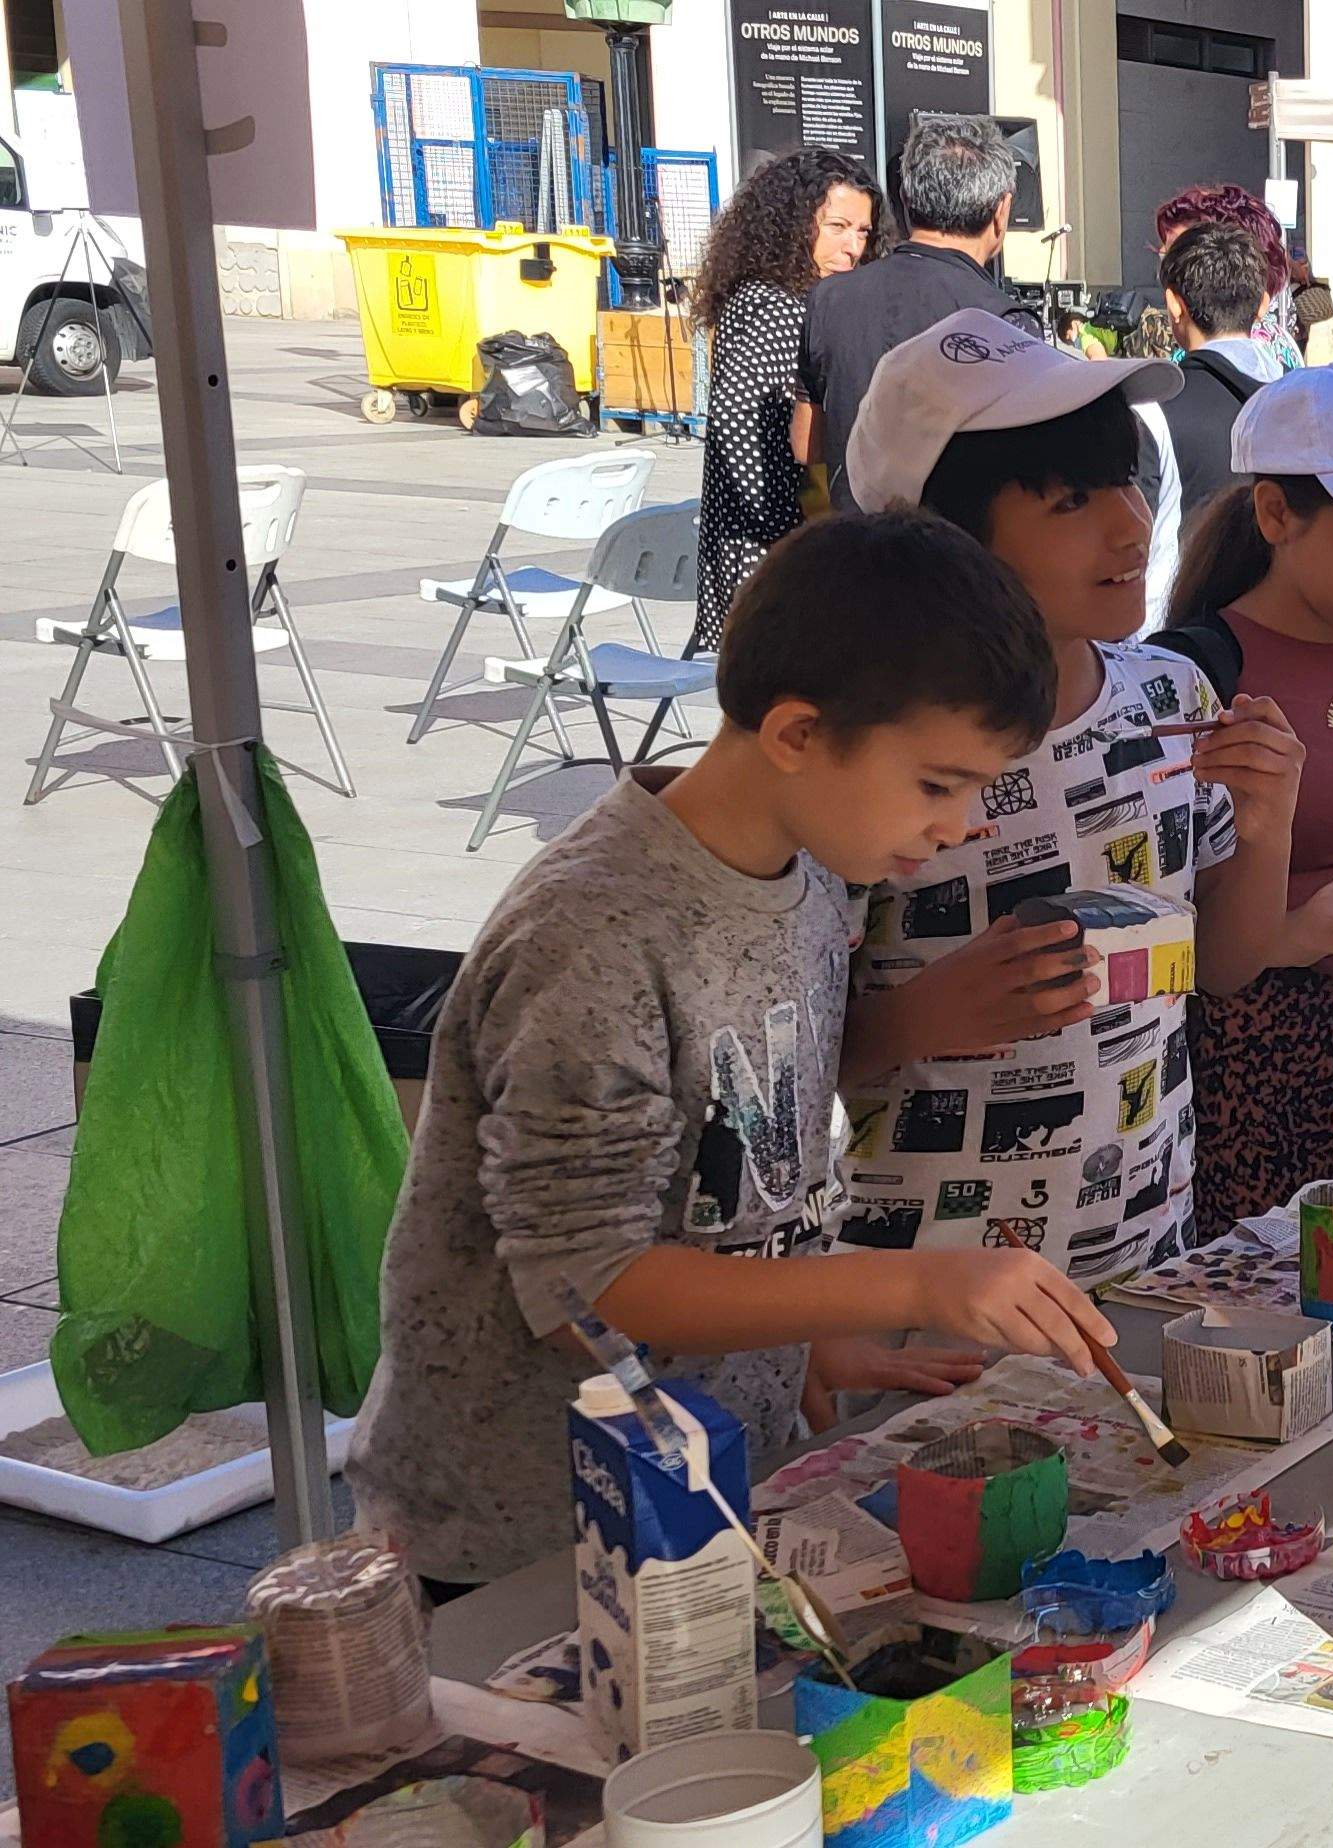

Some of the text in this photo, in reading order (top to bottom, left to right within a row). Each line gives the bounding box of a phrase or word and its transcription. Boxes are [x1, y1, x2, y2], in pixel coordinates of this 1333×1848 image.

[741, 22, 860, 44] OTROS MUNDOS
[892, 31, 983, 57] OTROS MUNDOS
[1146, 679, 1165, 698] 50
[946, 1182, 976, 1198] 50
